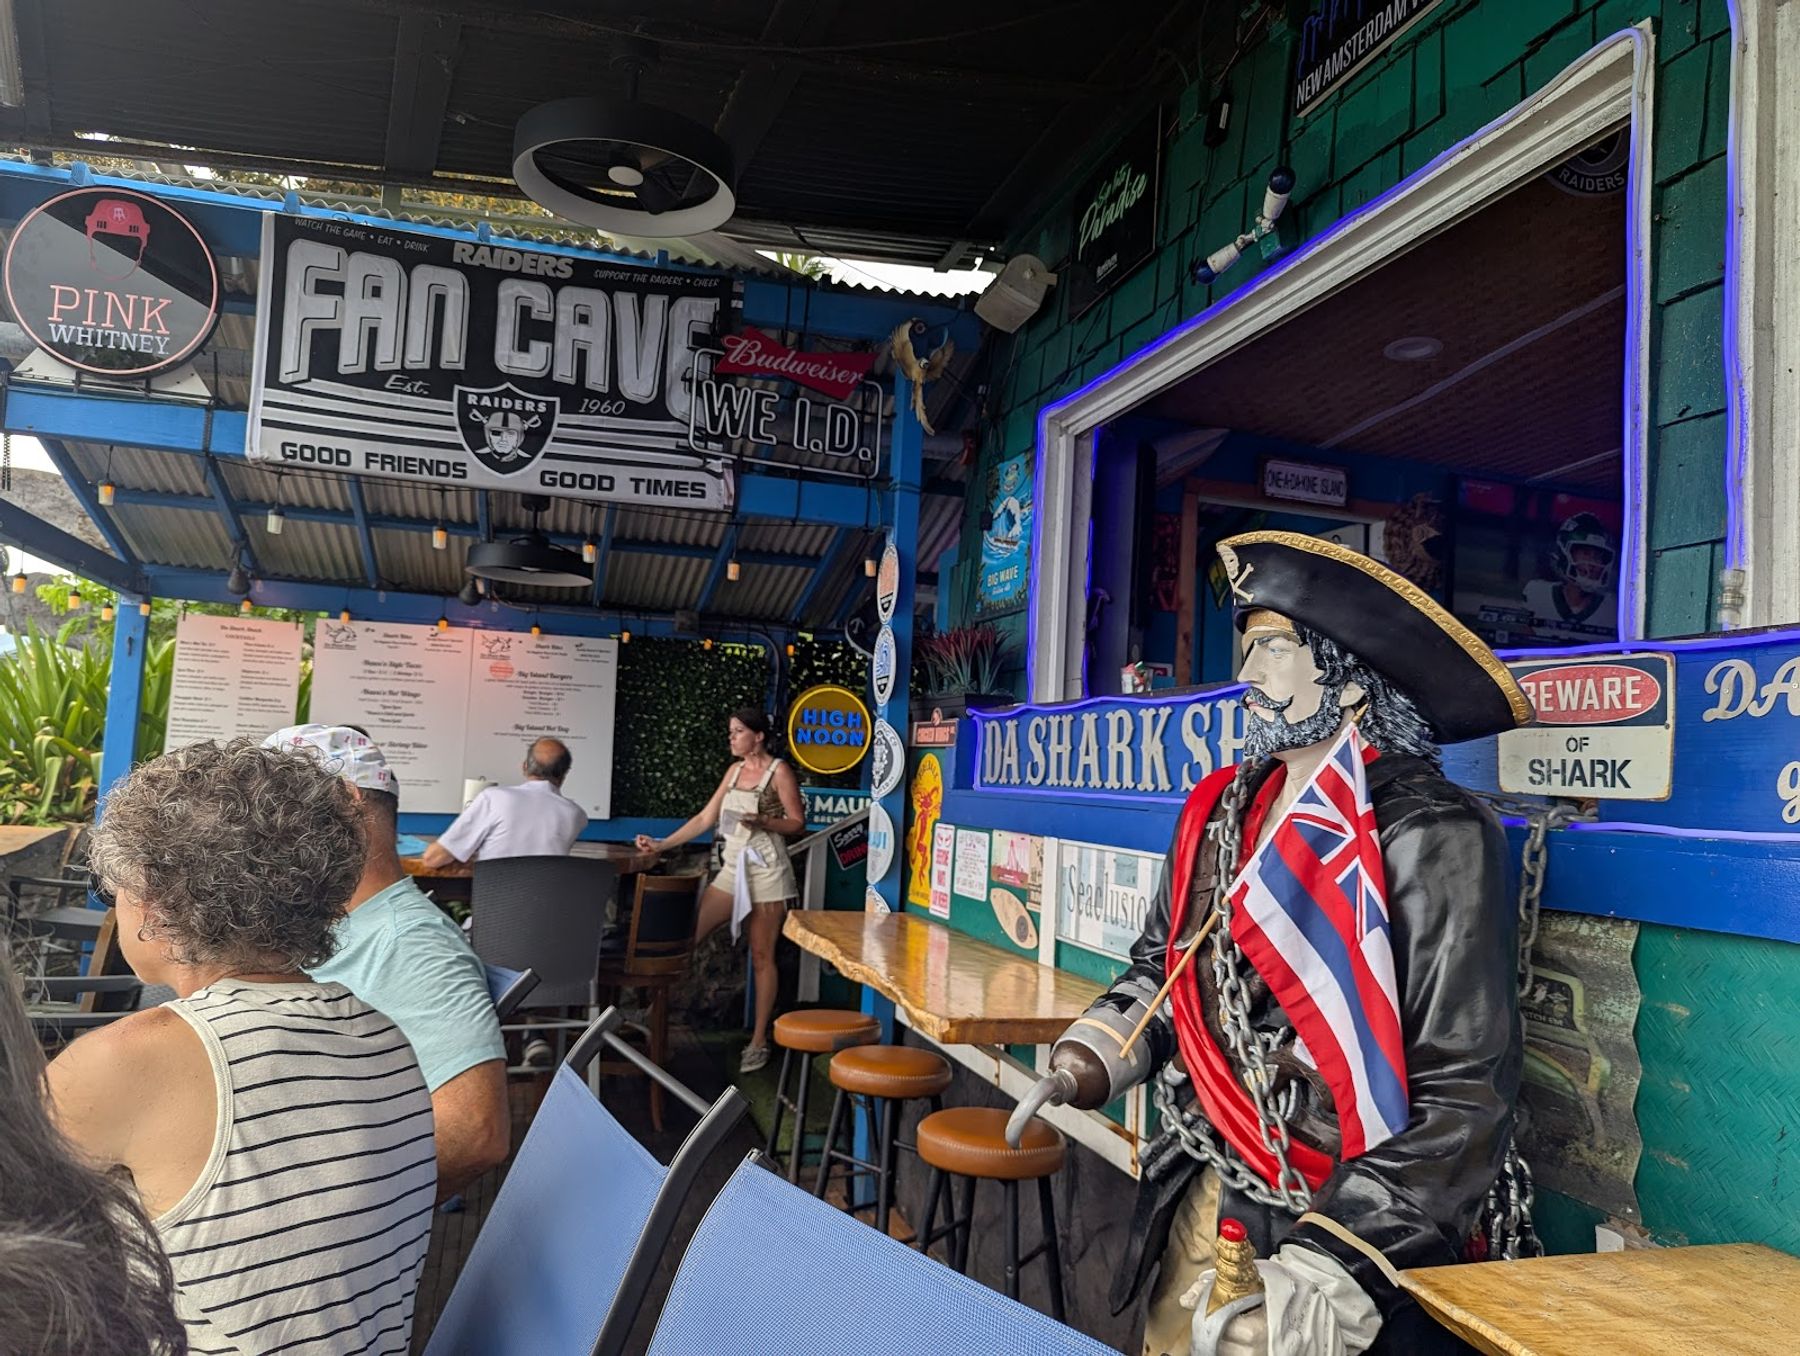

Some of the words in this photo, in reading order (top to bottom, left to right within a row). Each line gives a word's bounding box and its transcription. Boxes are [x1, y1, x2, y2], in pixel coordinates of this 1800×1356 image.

[1297, 65, 1324, 109] NEW
[1323, 0, 1408, 87] AMSTERDAM
[1558, 168, 1625, 191] RAIDERS
[1078, 167, 1148, 261] Paradise
[294, 216, 324, 231] WATCH
[325, 223, 342, 235] THE
[343, 227, 367, 241] GAME
[377, 235, 393, 246] EAT
[404, 239, 431, 253] DRINK
[453, 241, 575, 280] RAIDERS
[593, 268, 631, 283] SUPPORT
[632, 272, 648, 284] THE
[649, 274, 684, 287] RAIDERS
[693, 278, 720, 288] CHEER
[48, 284, 173, 335] PINK
[49, 323, 170, 355] WHITNEY
[278, 238, 471, 385] FAN
[494, 277, 721, 428] CAVE
[720, 334, 865, 386] Budweiser
[384, 374, 430, 395] Est.
[578, 398, 627, 416] 1960
[467, 392, 548, 414] RAIDERS
[702, 379, 780, 446] WE
[793, 397, 872, 462] I.D.
[280, 440, 353, 468] GOOD
[364, 452, 468, 481] FRIENDS
[539, 470, 616, 493] GOOD
[628, 477, 707, 500] TIMES
[987, 571, 999, 588] BIG
[999, 565, 1019, 584] WAVE
[796, 727, 866, 747] NOON
[802, 708, 862, 728] HIGH
[983, 718, 1021, 785] DA
[1025, 705, 1173, 793] SHARK
[1565, 736, 1590, 753] OF
[1527, 757, 1633, 789] SHARK
